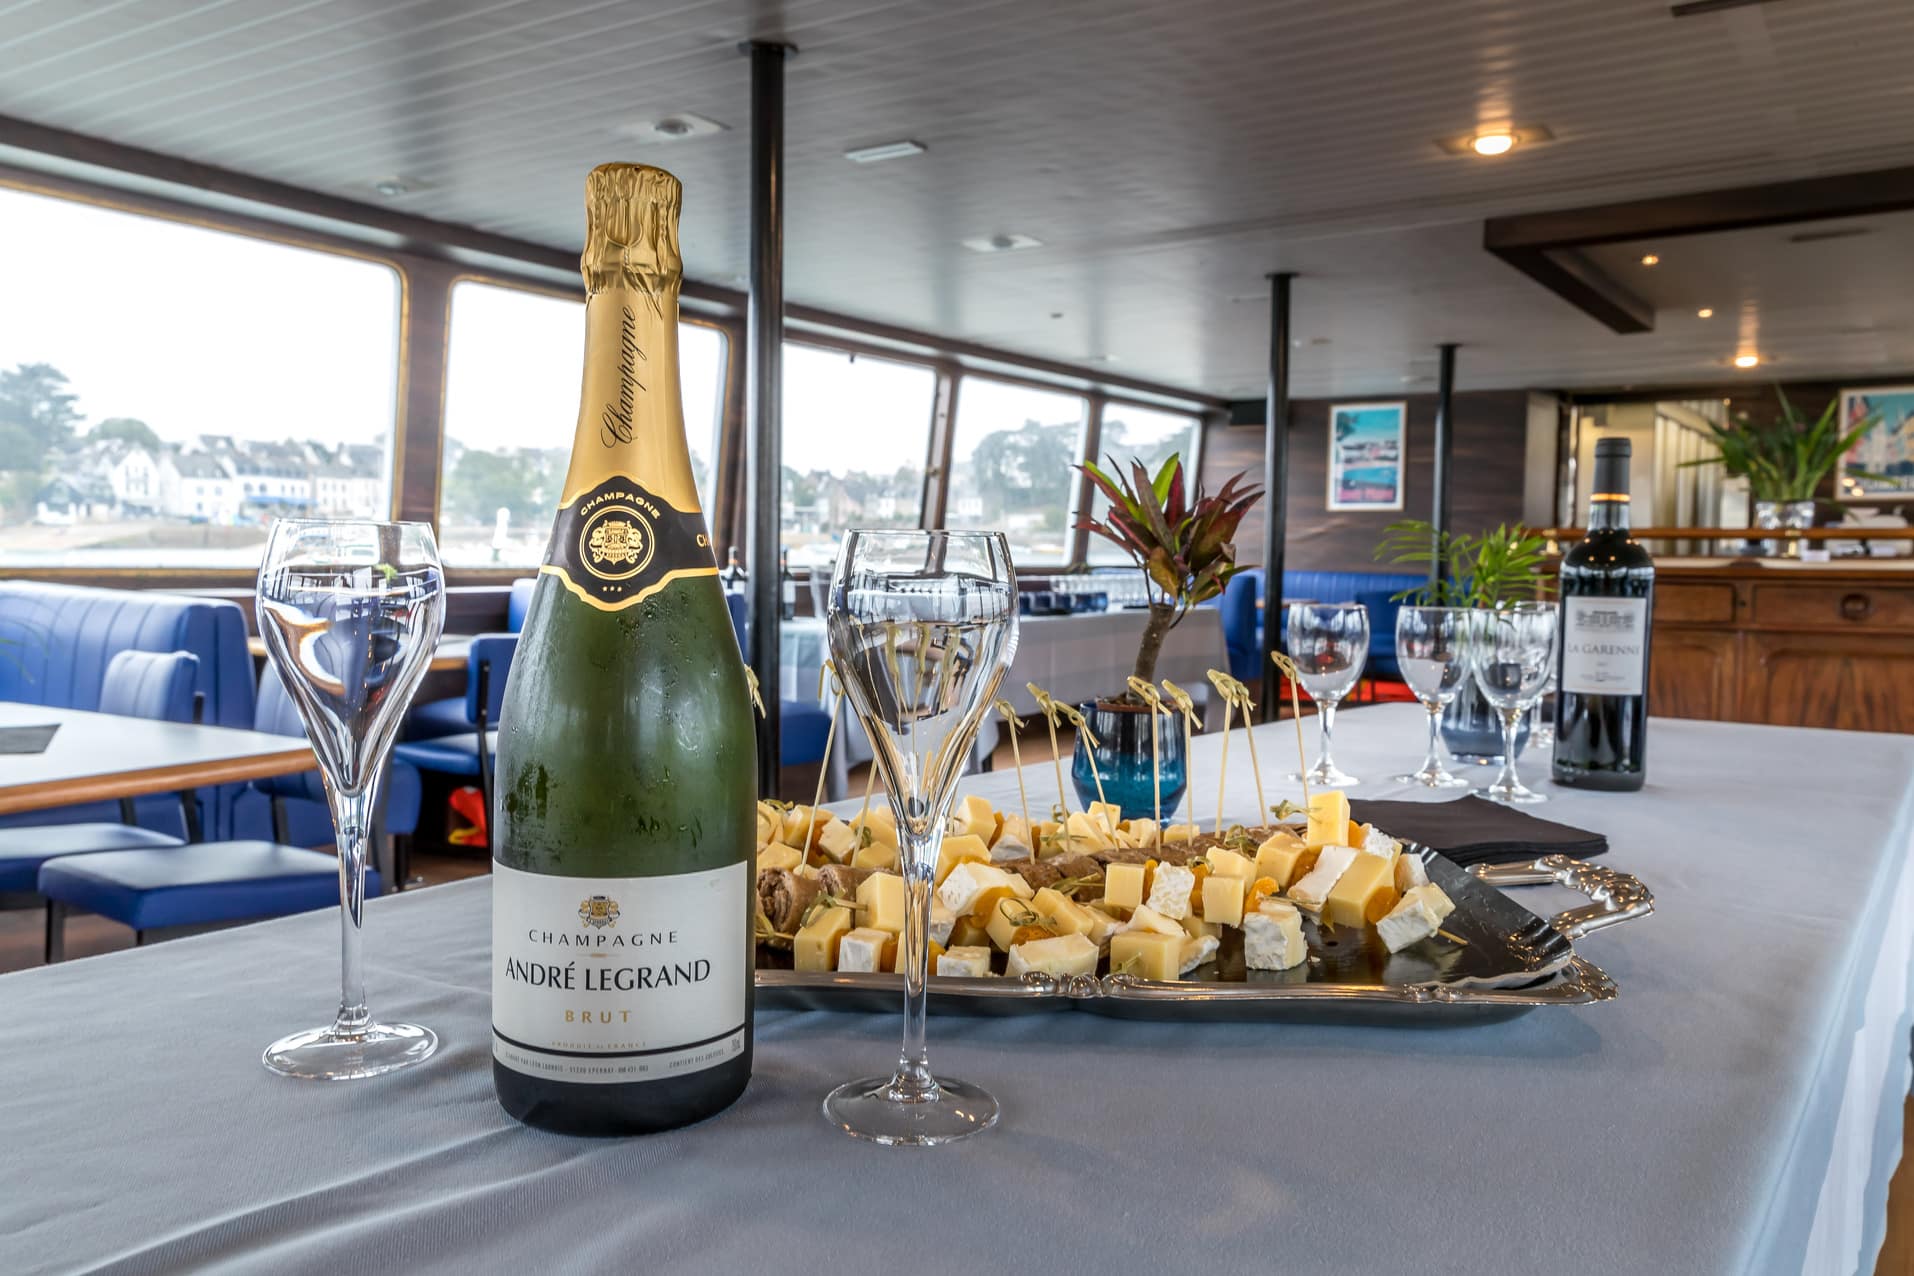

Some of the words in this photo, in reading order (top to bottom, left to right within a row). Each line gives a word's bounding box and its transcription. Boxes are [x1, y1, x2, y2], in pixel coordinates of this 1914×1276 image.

[600, 304, 648, 449] Champagne
[580, 491, 662, 520] CHAMPAGNE
[528, 929, 678, 947] CHAMPAGNE
[505, 956, 576, 990] ANDRÉ
[585, 958, 711, 992] LEGRAND
[565, 1009, 632, 1024] BRUT
